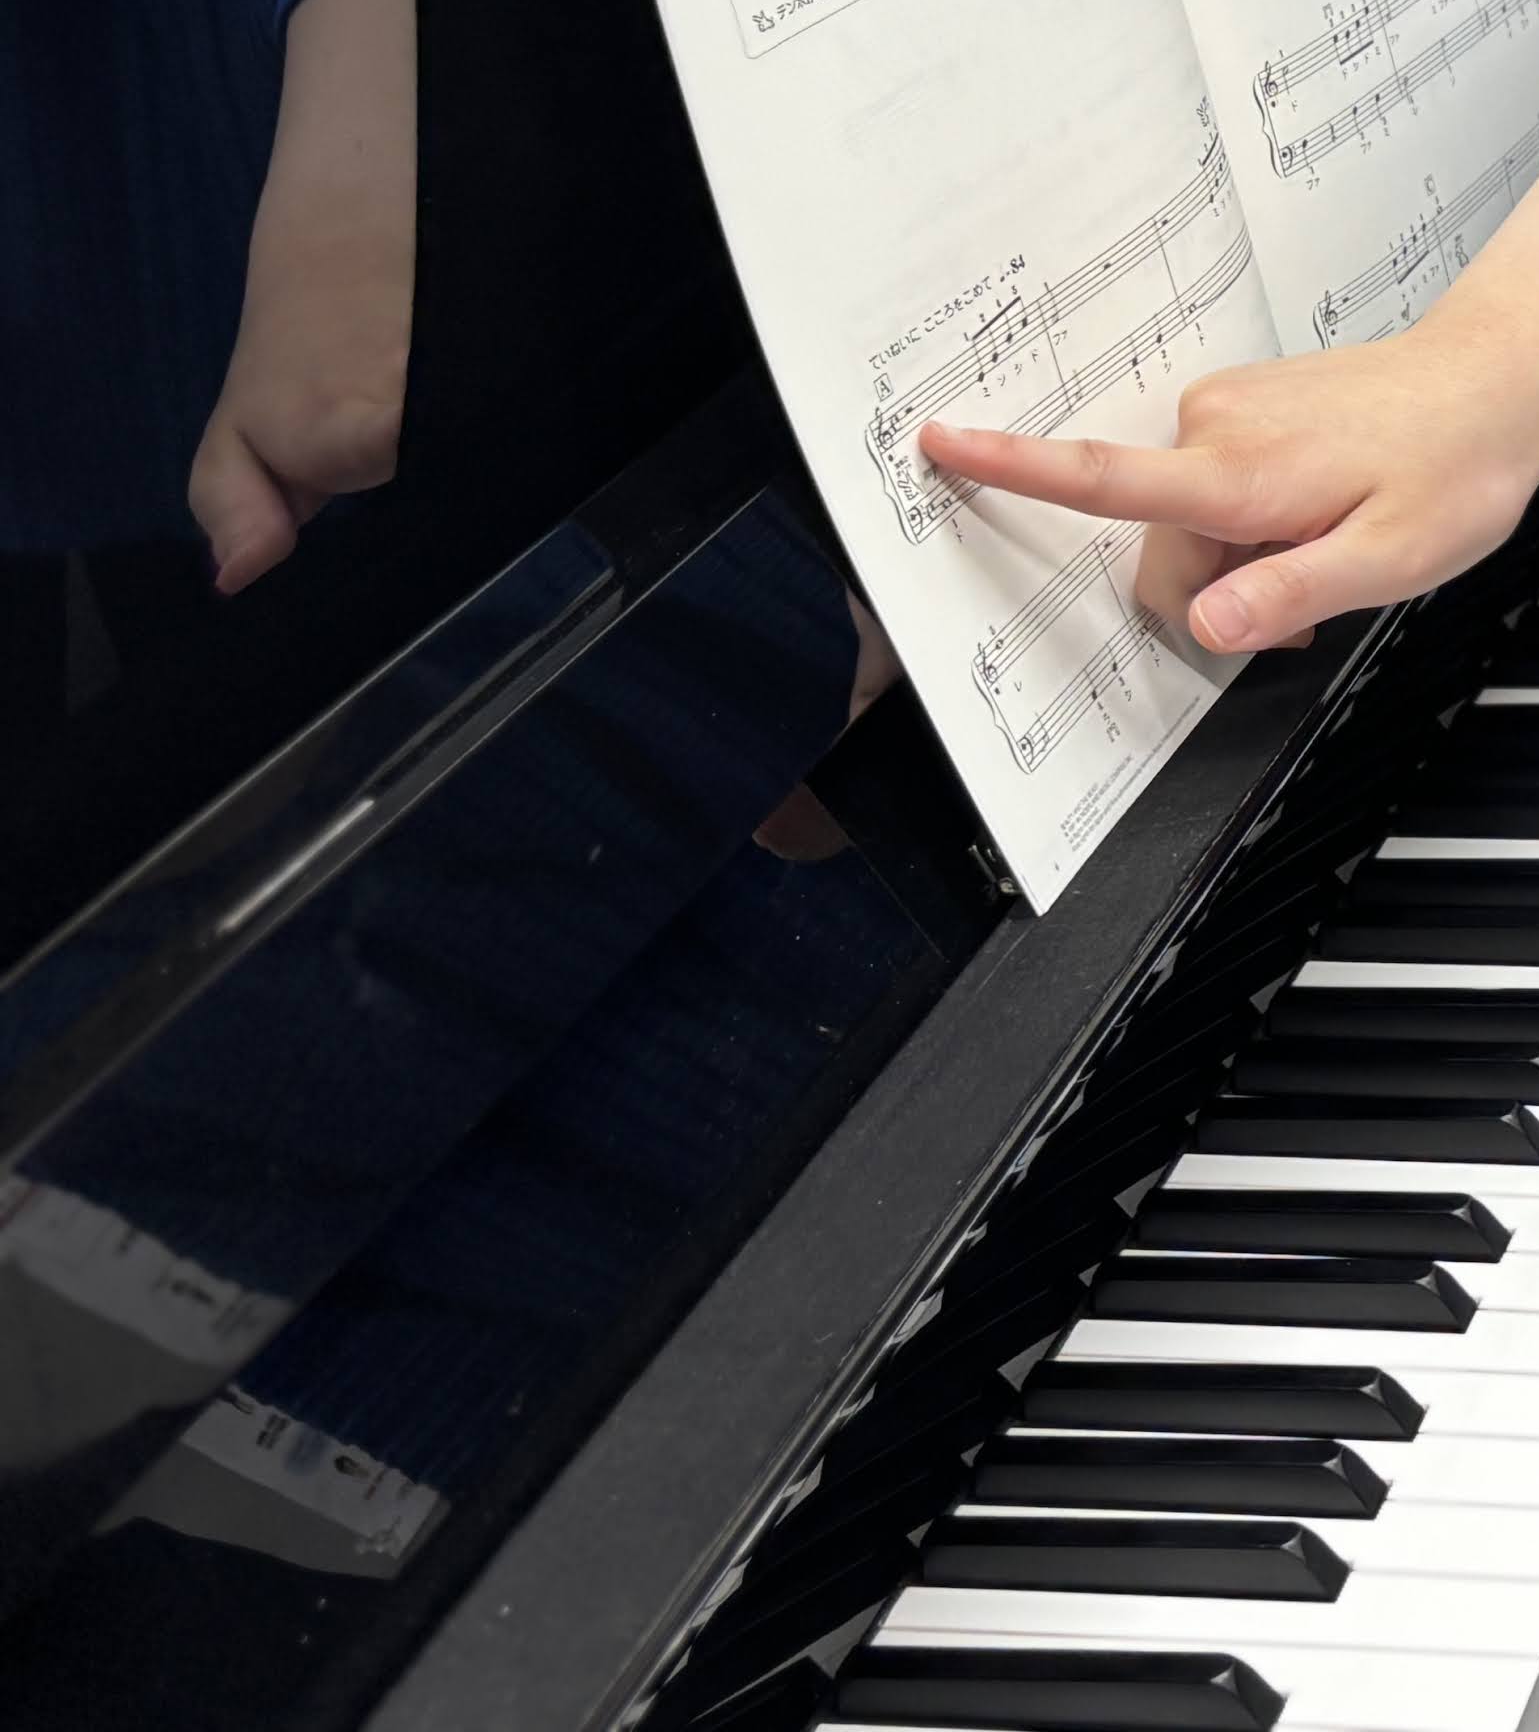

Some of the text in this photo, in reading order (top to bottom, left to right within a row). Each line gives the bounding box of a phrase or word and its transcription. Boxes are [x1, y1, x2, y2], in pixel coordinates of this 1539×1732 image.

[868, 326, 921, 370] ていねいに
[923, 275, 993, 333] こころをこめて
